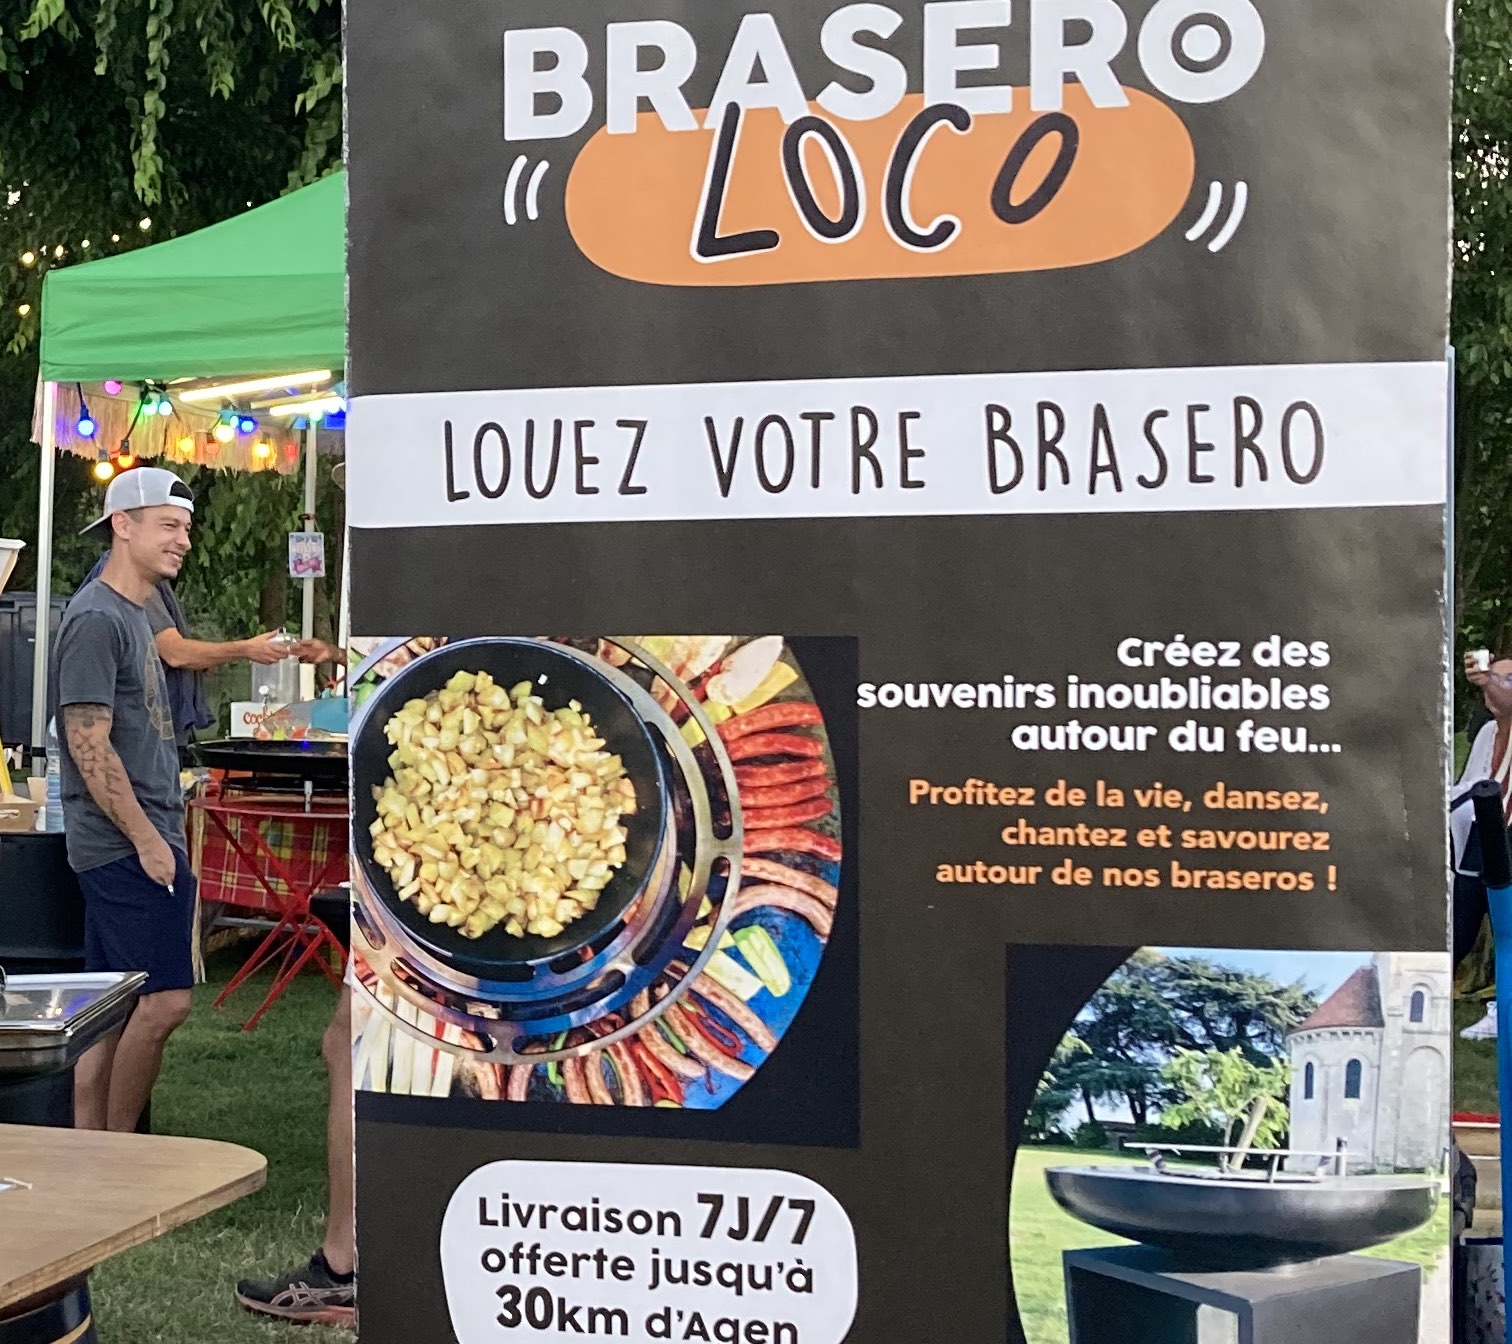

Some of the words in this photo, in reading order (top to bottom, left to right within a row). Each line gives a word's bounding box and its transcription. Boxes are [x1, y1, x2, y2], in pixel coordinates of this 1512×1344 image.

[692, 103, 1079, 264] LOCO
[443, 416, 650, 504] LOUEZ
[703, 407, 928, 499] VOTRE
[986, 396, 1327, 495] BRASERO
[1117, 634, 1241, 667] Créez
[1252, 636, 1330, 667] des
[857, 675, 1056, 709] souvenirs
[1068, 675, 1330, 710] inoubliables
[1012, 721, 1157, 752] autour
[1168, 720, 1224, 753] du
[1237, 720, 1341, 753] feu...
[909, 777, 1035, 807] Profitez
[1045, 780, 1087, 808] de
[1096, 781, 1124, 808] la
[1135, 782, 1192, 812] vie,
[1203, 782, 1328, 814] dansez,
[1002, 819, 1127, 848] chantez
[1137, 825, 1171, 849] et
[1181, 828, 1329, 851] savourez
[936, 862, 1042, 885] autour
[1051, 859, 1092, 886] de
[1103, 867, 1160, 888] nos
[1170, 861, 1314, 891] braseros
[1327, 866, 1337, 891] !
[479, 1193, 682, 1236] Livraison
[697, 1193, 816, 1245] 7J/7
[481, 1242, 635, 1281] offerte
[649, 1248, 813, 1296] jusqu'à
[495, 1284, 628, 1335] 30km
